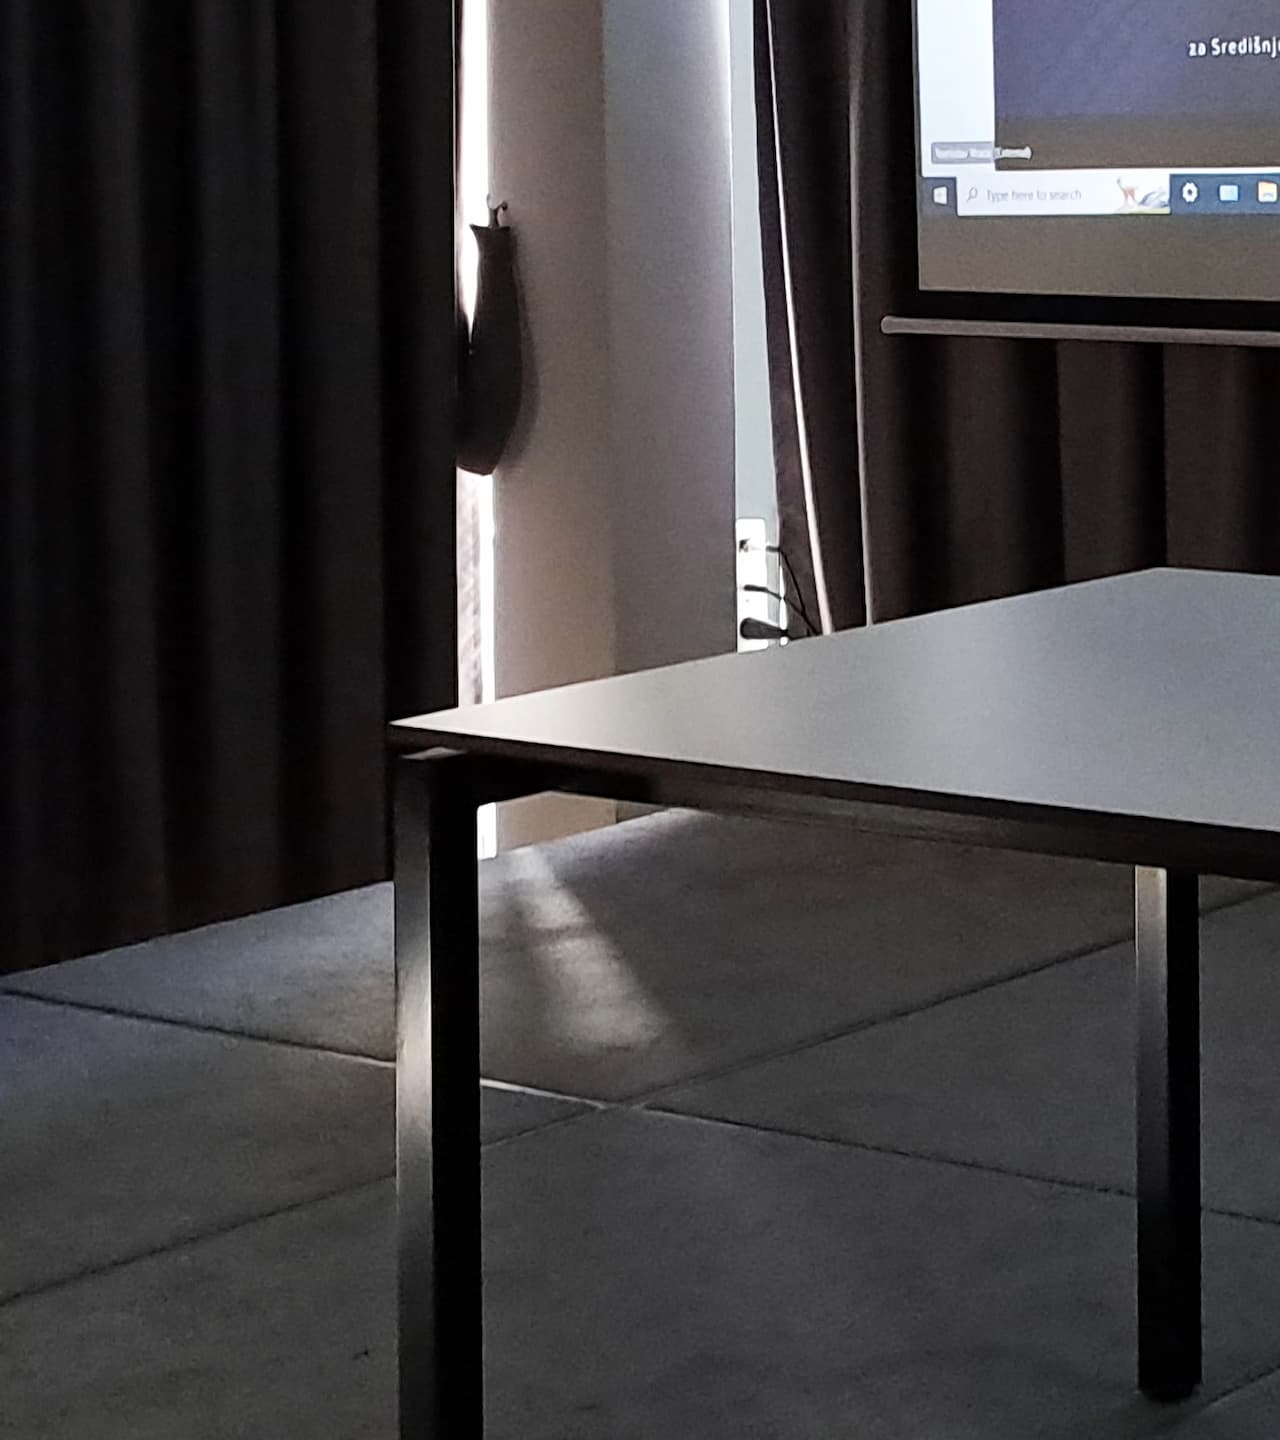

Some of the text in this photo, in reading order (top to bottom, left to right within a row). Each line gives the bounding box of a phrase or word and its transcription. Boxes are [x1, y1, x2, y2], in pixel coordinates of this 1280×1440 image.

[1188, 41, 1207, 58] za
[1036, 189, 1047, 201] to
[1049, 189, 1082, 201] search
